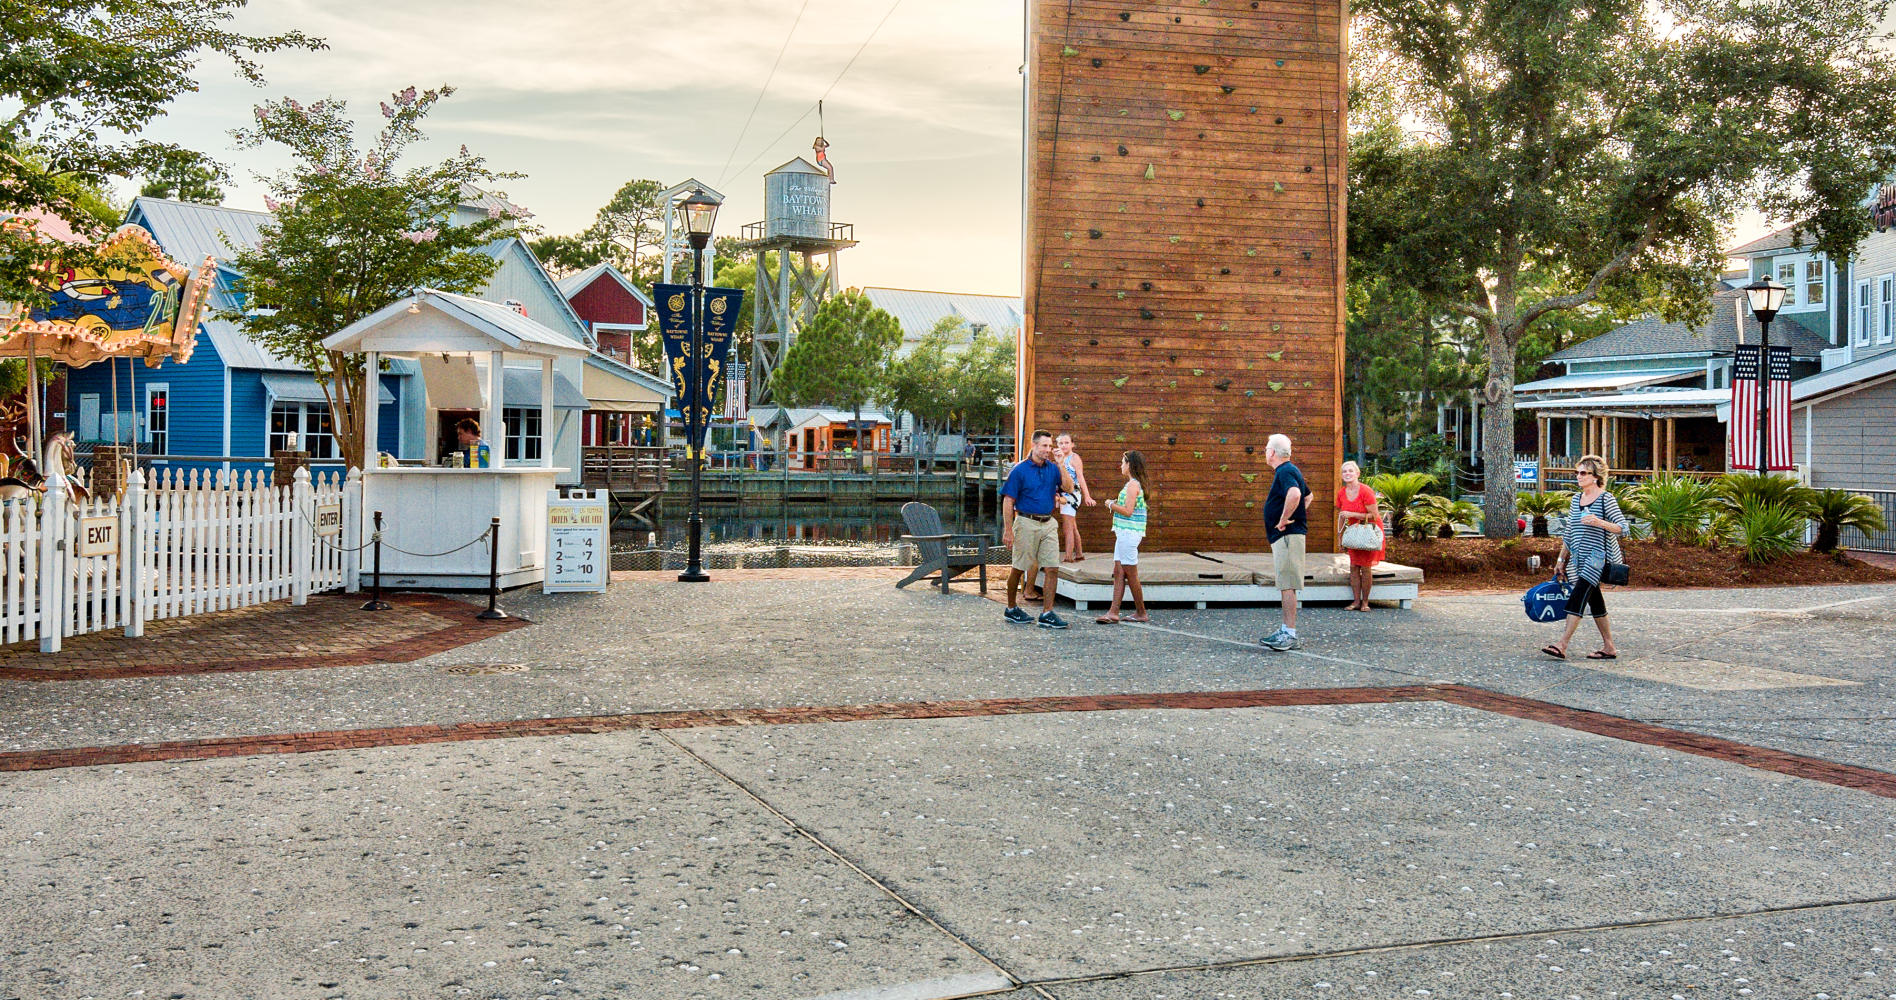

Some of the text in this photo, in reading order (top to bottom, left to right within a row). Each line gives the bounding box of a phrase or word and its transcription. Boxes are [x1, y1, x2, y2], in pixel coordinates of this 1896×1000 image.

[143, 280, 179, 335] 24
[320, 512, 338, 527] ENTER
[88, 526, 112, 545] EXIT
[556, 538, 562, 547] 1
[556, 551, 563, 560] 2
[555, 564, 563, 574] 3
[578, 564, 593, 574] $10
